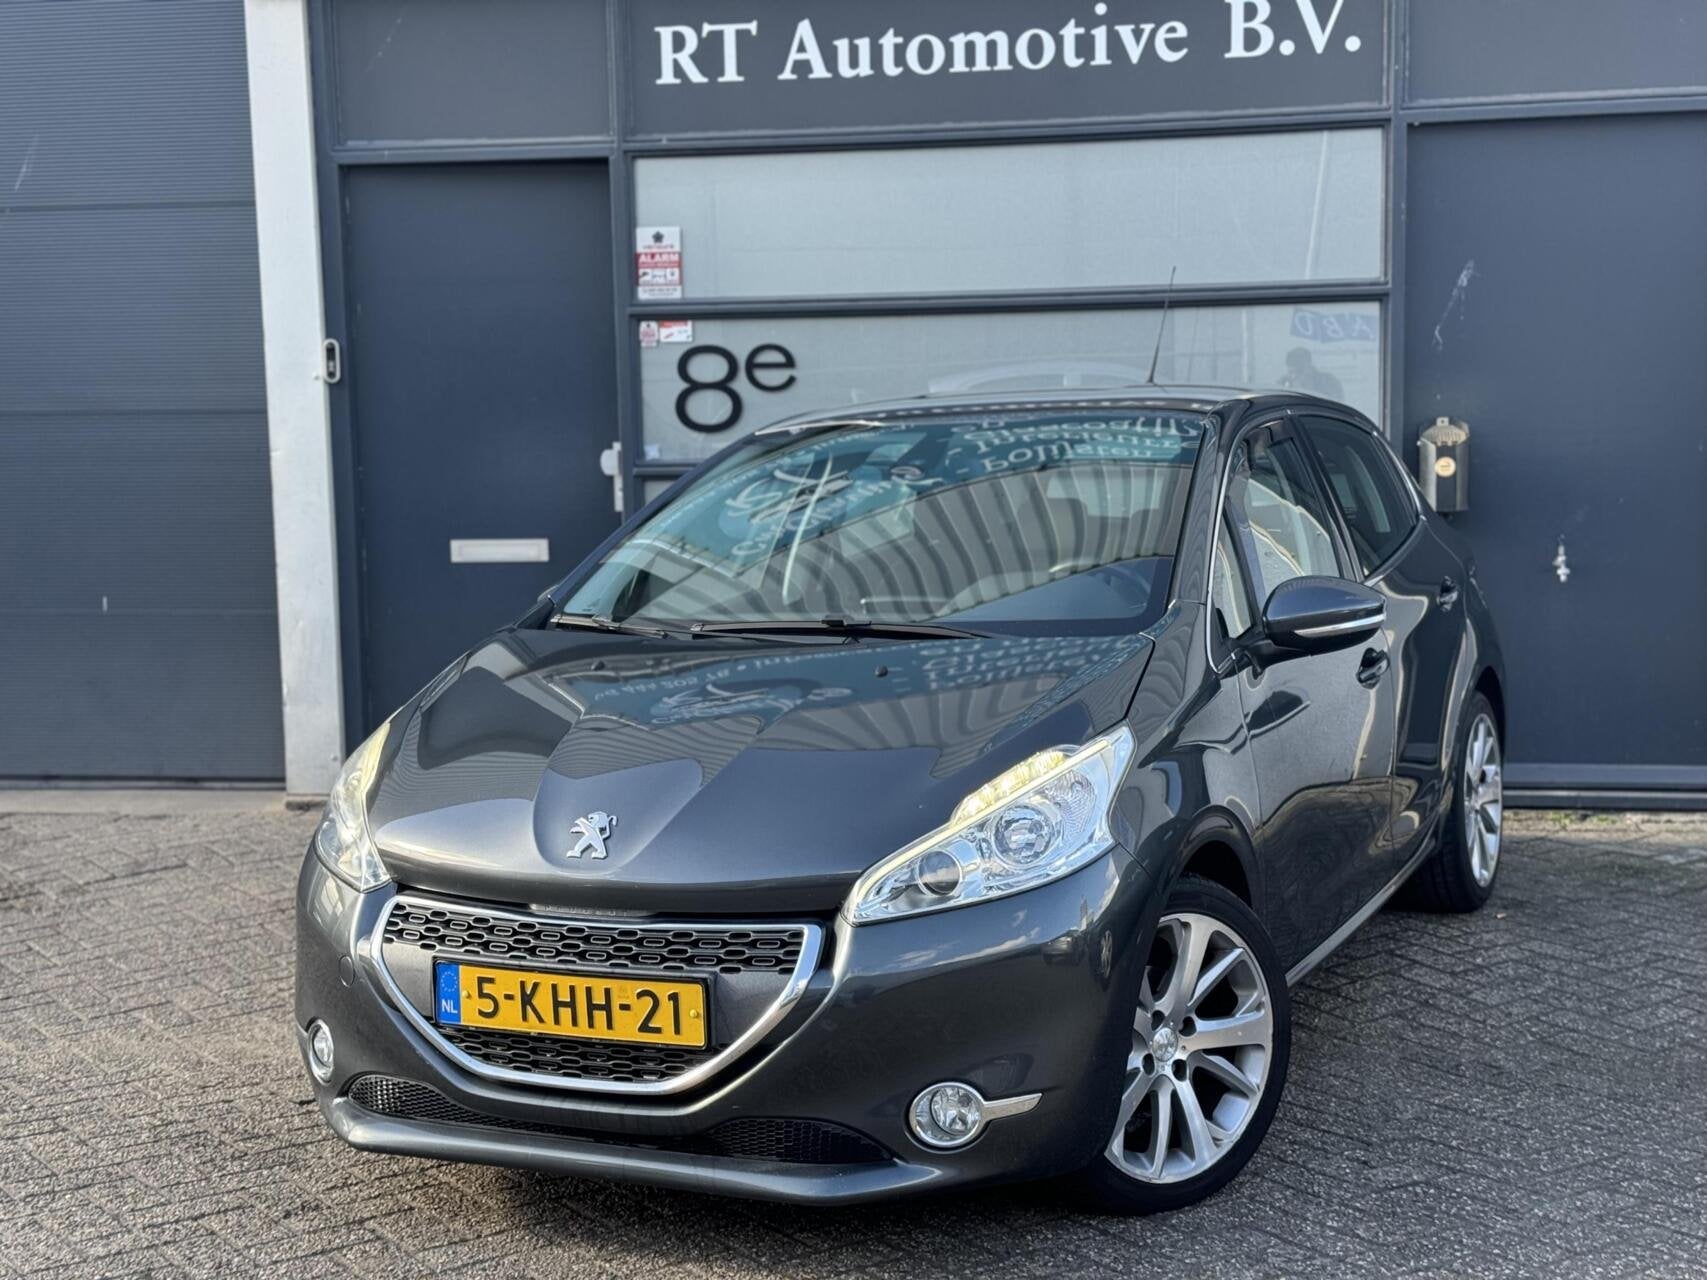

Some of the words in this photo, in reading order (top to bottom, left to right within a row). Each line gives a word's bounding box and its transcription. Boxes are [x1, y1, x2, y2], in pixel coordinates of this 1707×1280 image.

[654, 20, 758, 85] RT
[777, 3, 1188, 81] Automotive
[1224, 0, 1362, 59] B.V.
[441, 999, 458, 1014] NL
[476, 975, 682, 1036] 5-KHH-21
